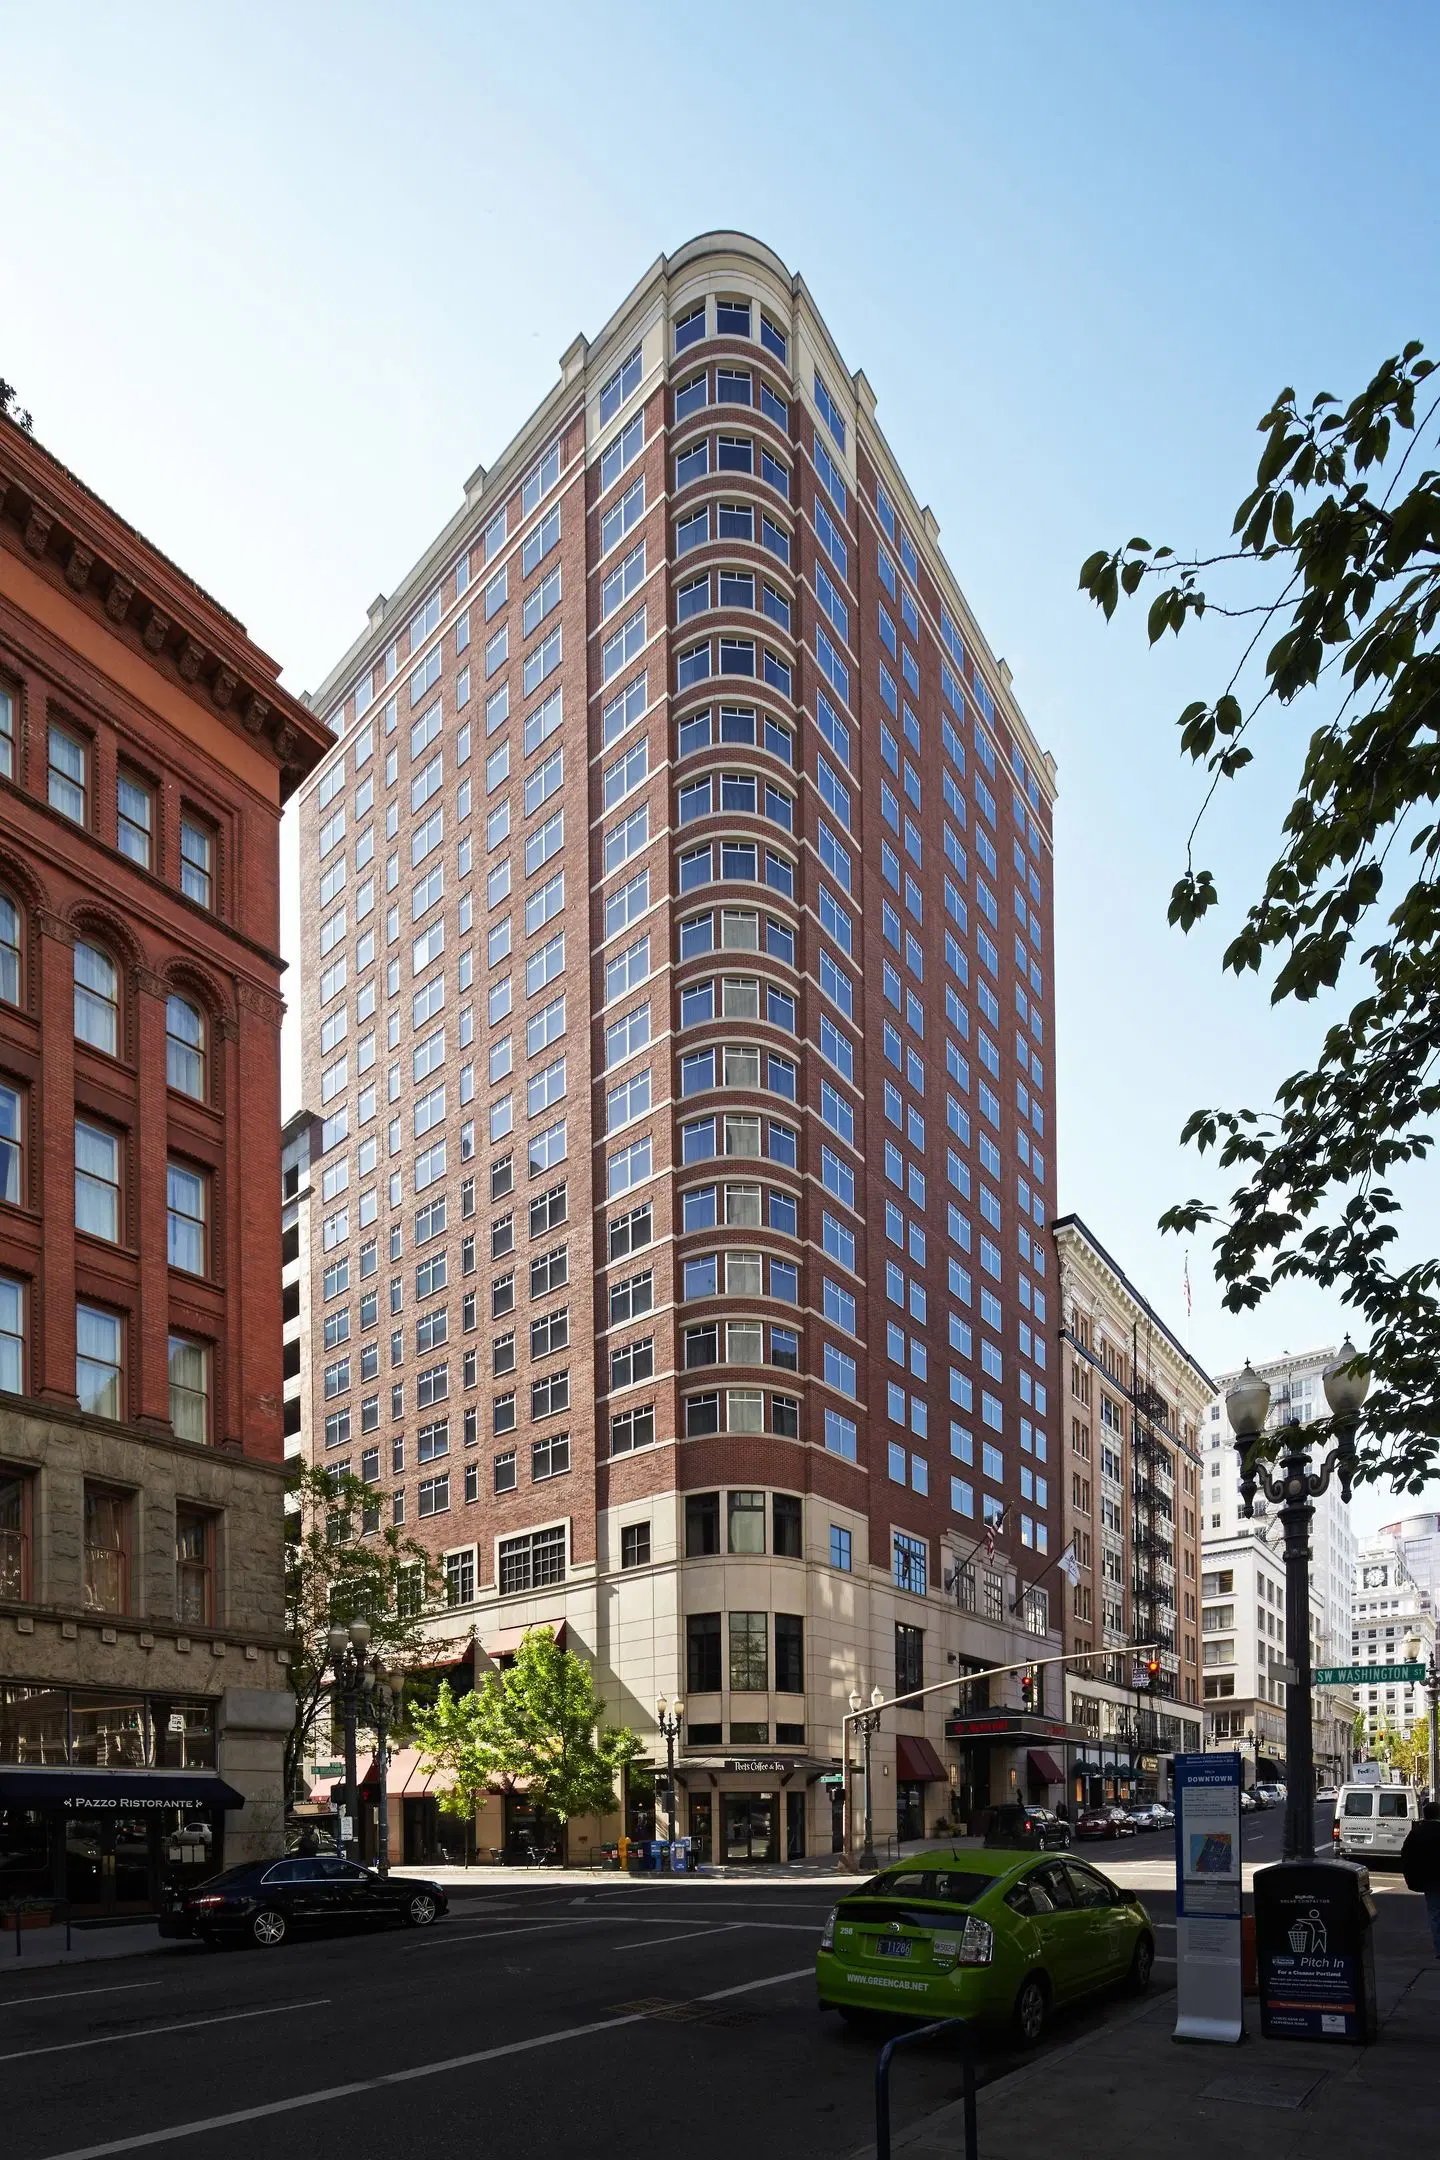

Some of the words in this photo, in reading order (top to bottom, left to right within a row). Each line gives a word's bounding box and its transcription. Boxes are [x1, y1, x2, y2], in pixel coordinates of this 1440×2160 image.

[1317, 1671, 1333, 1683] SW
[1338, 1667, 1409, 1682] WASHINGTON
[1413, 1668, 1424, 1677] ST
[751, 1761, 769, 1772] Coffee
[775, 1761, 785, 1771] Tea
[75, 1798, 118, 1808] PAZZO
[119, 1798, 194, 1808] RISTORANTE
[1300, 1957, 1330, 1968] Pitch
[1333, 1958, 1345, 1969] In
[847, 1973, 929, 1992] WWW.GREENCAB.NET
